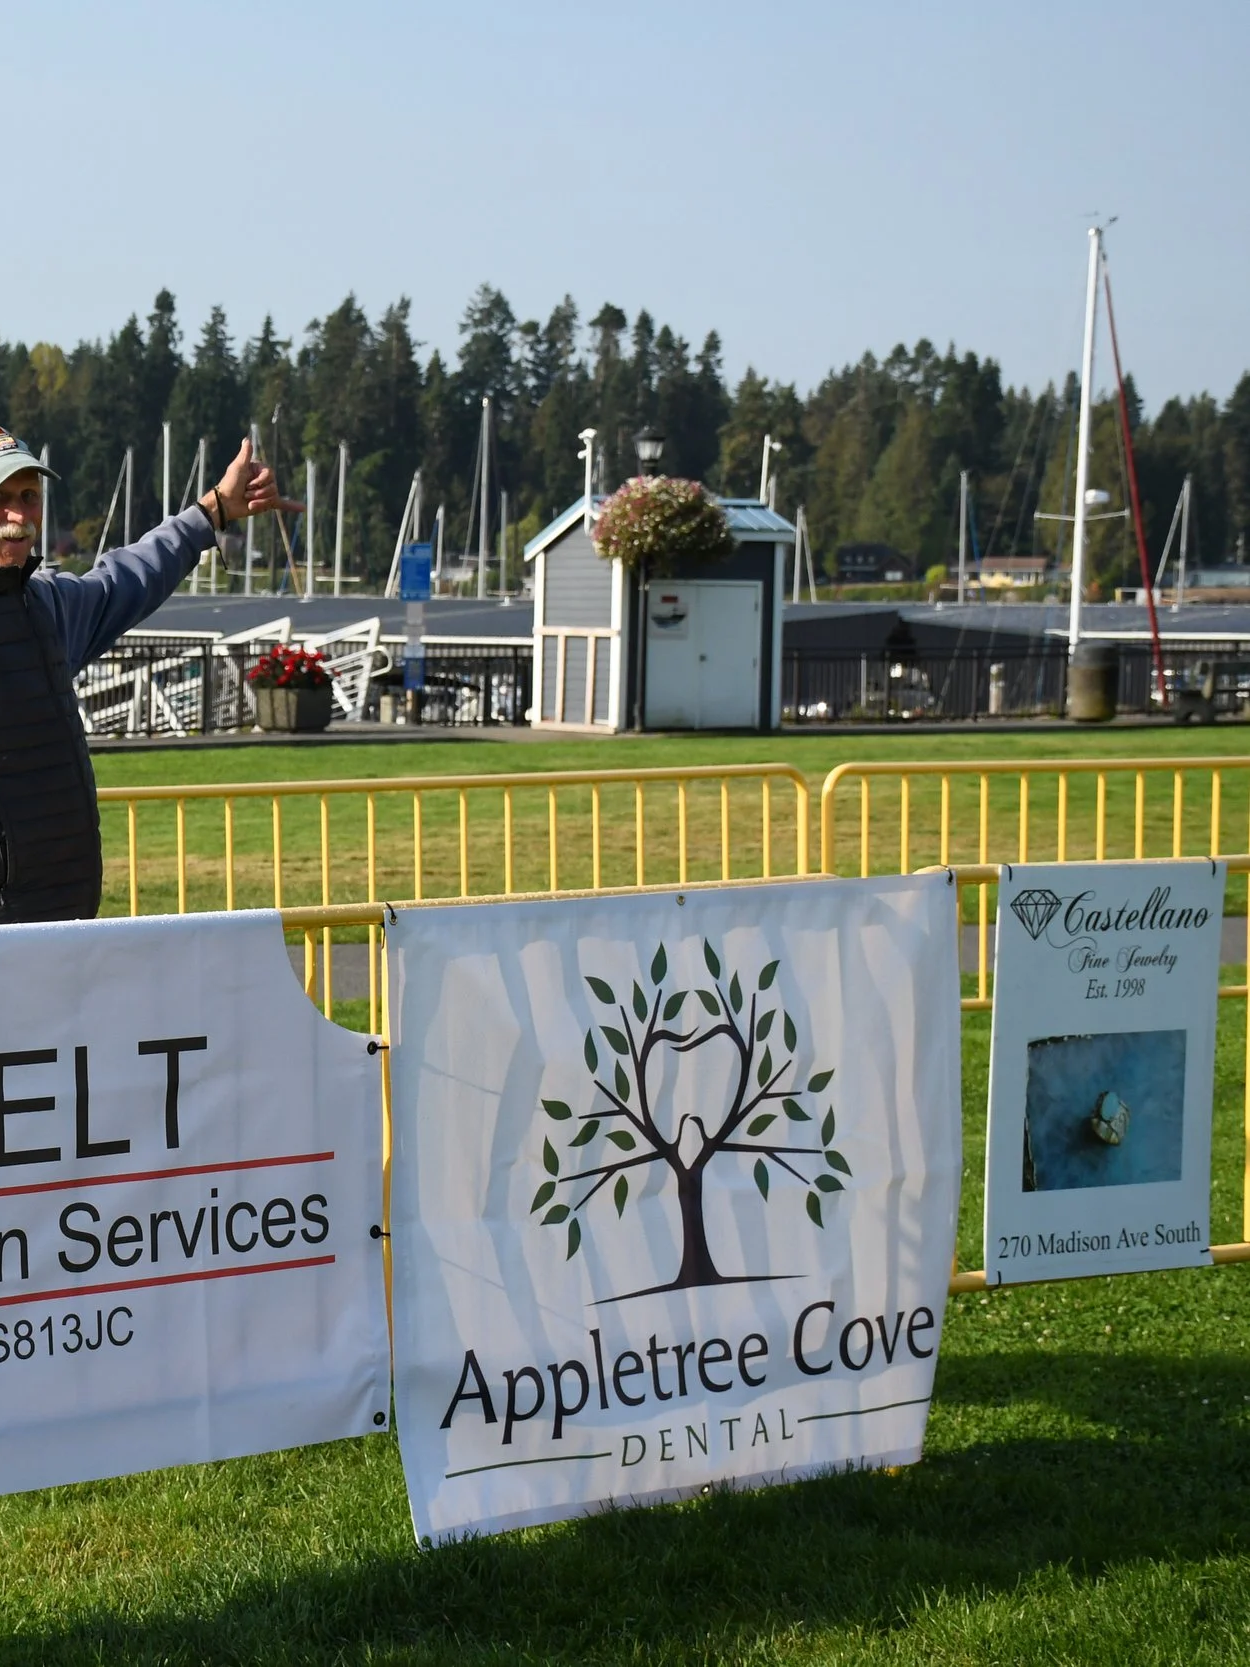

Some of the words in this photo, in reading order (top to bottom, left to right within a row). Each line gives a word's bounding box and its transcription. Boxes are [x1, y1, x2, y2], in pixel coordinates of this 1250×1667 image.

[1063, 886, 1212, 936] Castellano
[1068, 947, 1109, 973] Fine
[1116, 944, 1178, 974] Jewelry
[1085, 979, 1107, 999] Est.
[1114, 978, 1145, 998] 1998
[57, 1187, 330, 1274] Services
[998, 1235, 1031, 1259] 270
[1037, 1230, 1110, 1256] Madison
[1116, 1228, 1149, 1249] Ave
[1154, 1220, 1201, 1245] South
[440, 1328, 769, 1445] Appletree
[794, 1300, 935, 1376] Cove
[621, 1407, 795, 1467] DENTAL
